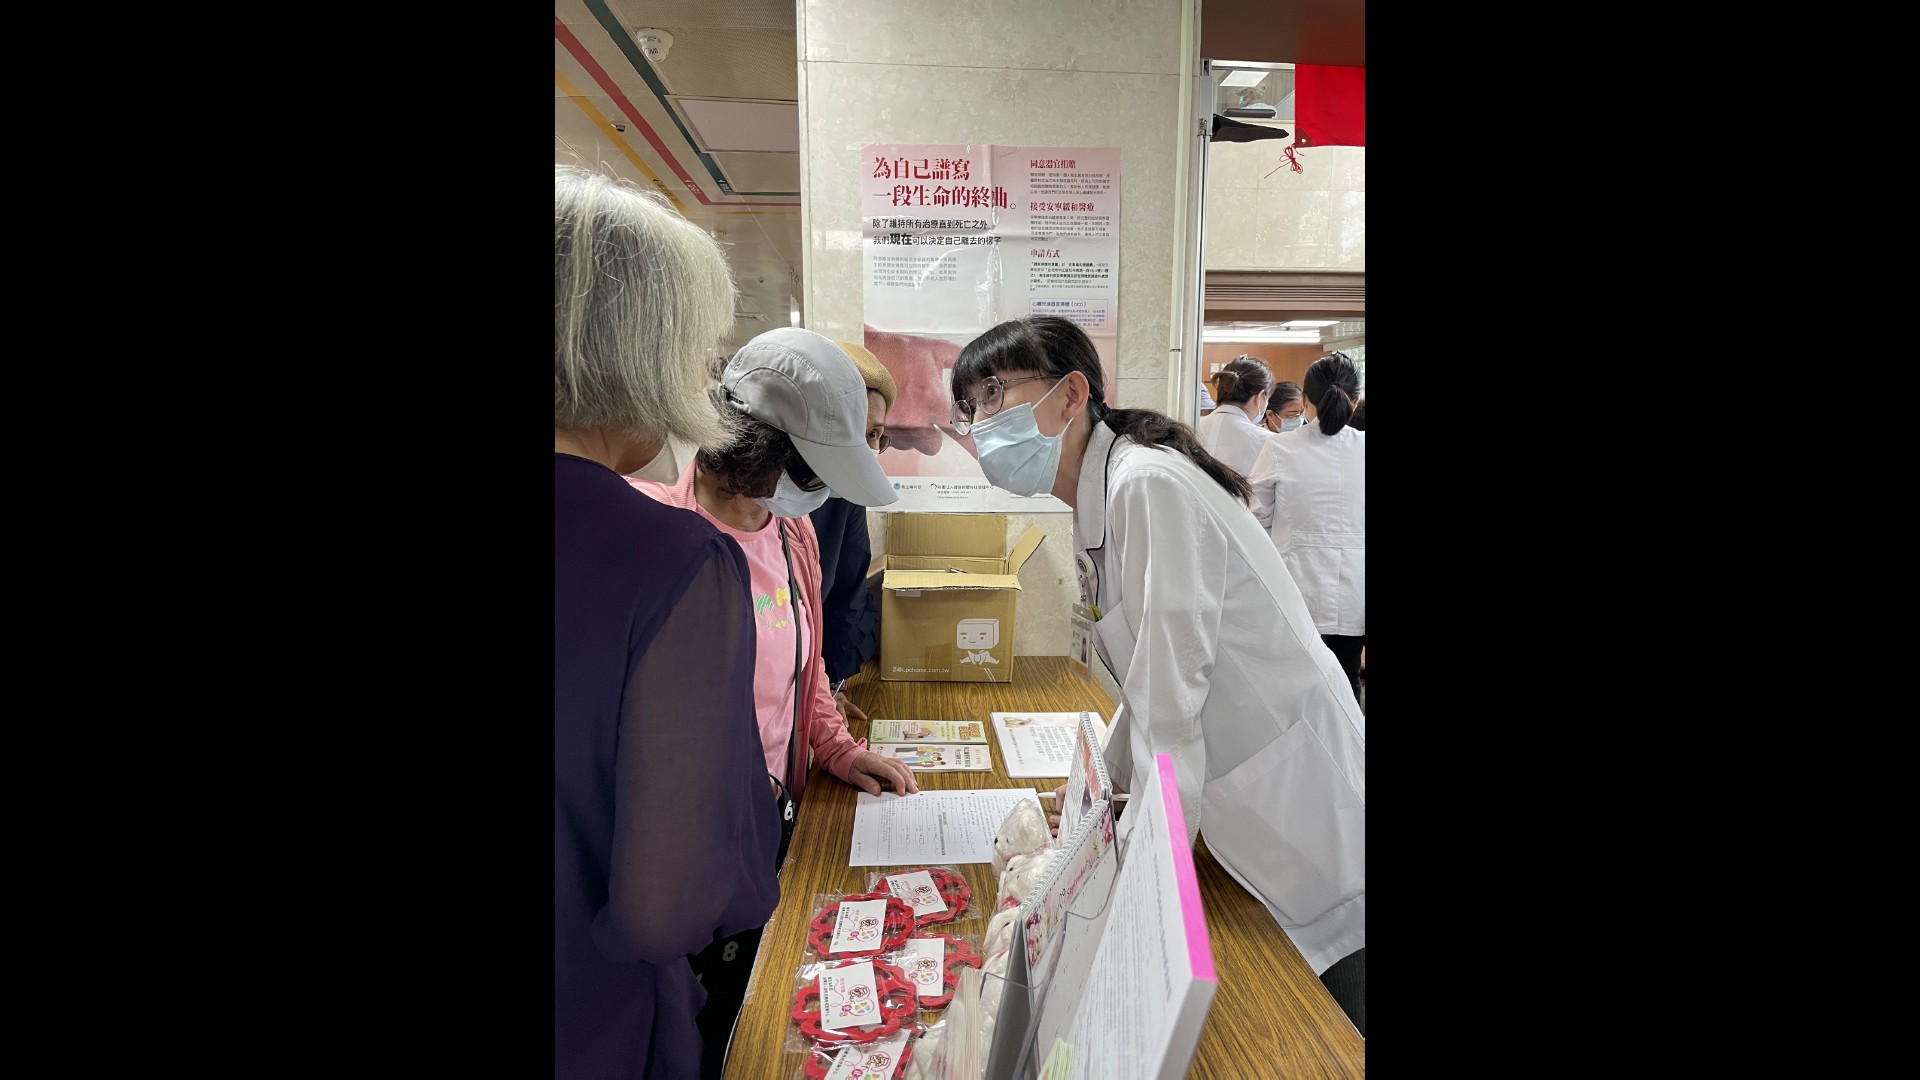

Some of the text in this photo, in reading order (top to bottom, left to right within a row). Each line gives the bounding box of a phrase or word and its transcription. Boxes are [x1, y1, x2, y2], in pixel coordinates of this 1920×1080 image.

[872, 157, 971, 181] 為自己譜寫
[722, 941, 738, 961] 8
